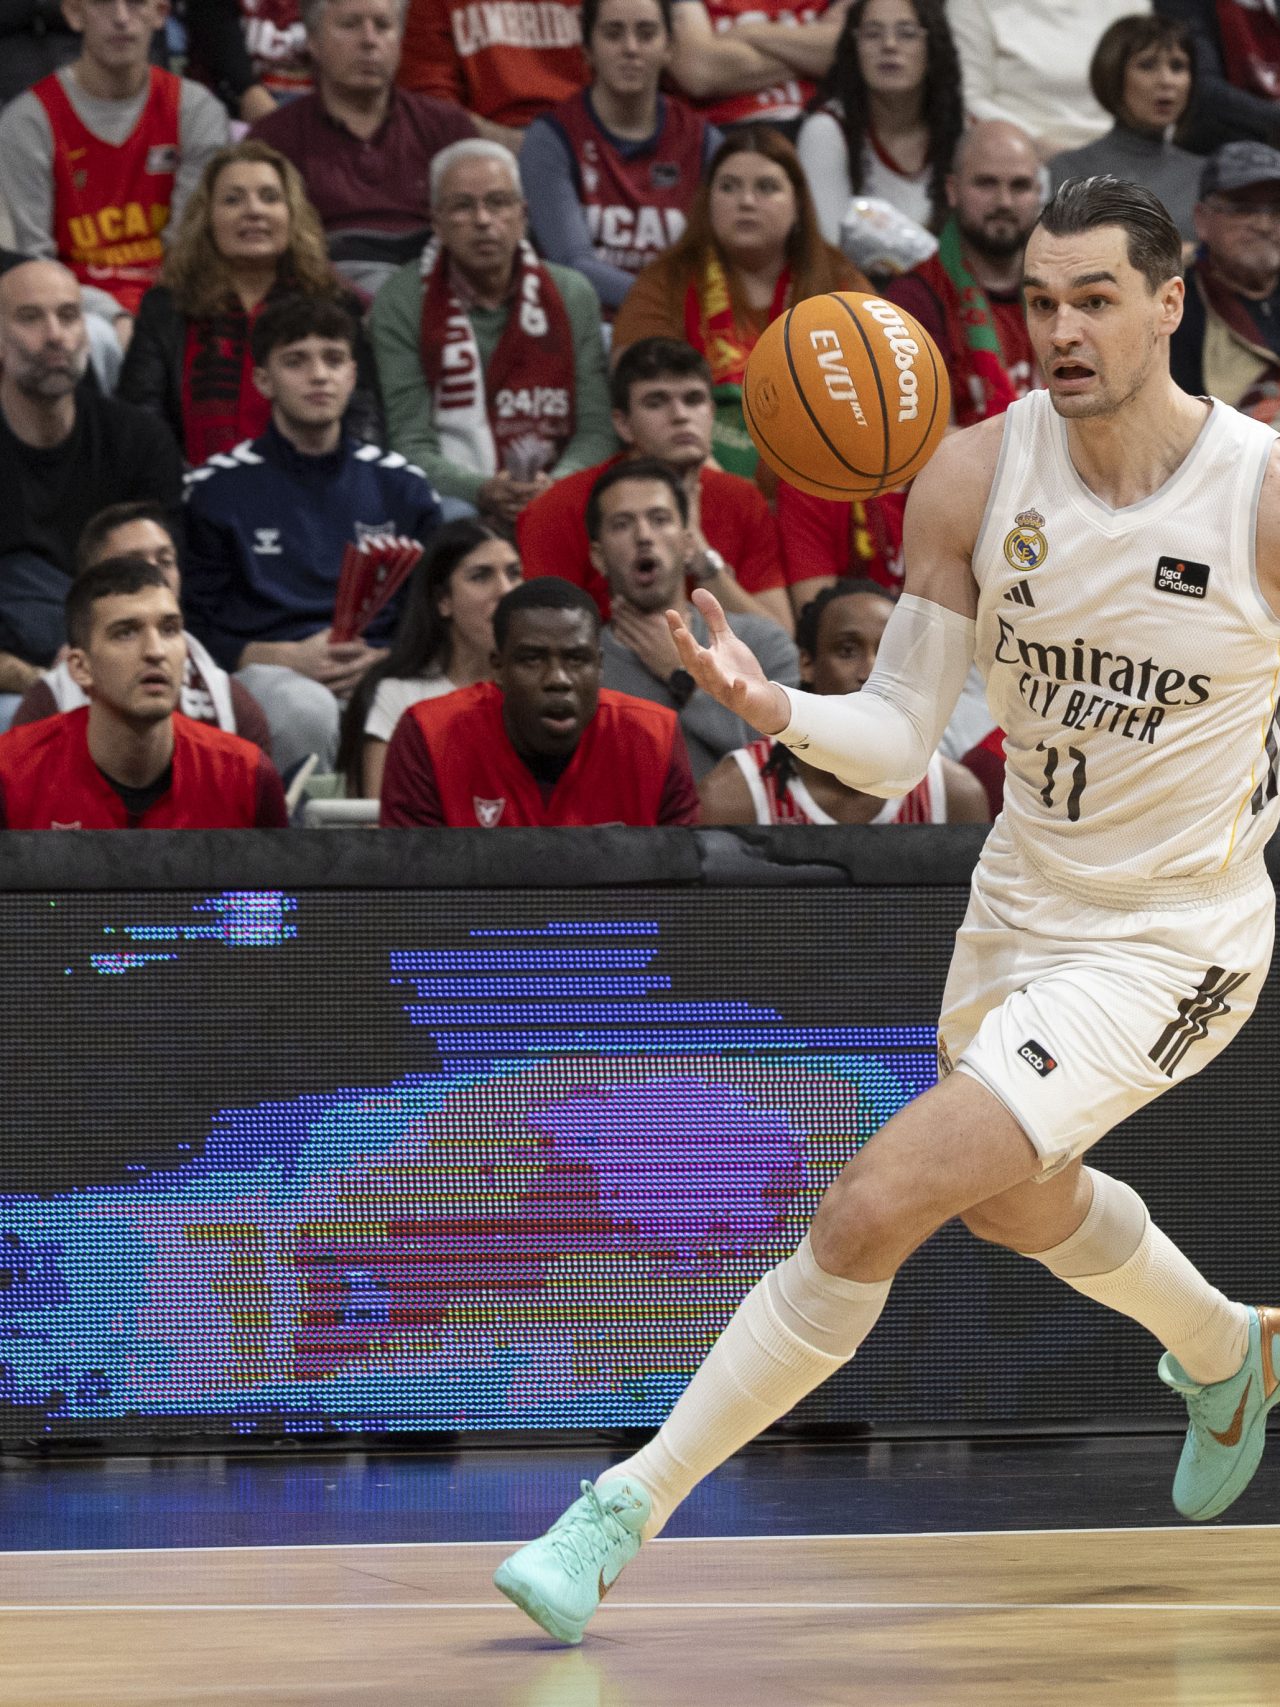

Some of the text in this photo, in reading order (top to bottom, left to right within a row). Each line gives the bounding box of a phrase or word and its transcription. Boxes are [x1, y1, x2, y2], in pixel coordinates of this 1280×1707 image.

[810, 329, 857, 400] EVO
[863, 299, 919, 423] Wilson
[1158, 579, 1204, 595] endesa
[1160, 566, 1181, 580] liga
[995, 614, 1211, 706] Emirates
[1019, 672, 1165, 744] FLY BETTER
[1021, 1047, 1044, 1070] acb
